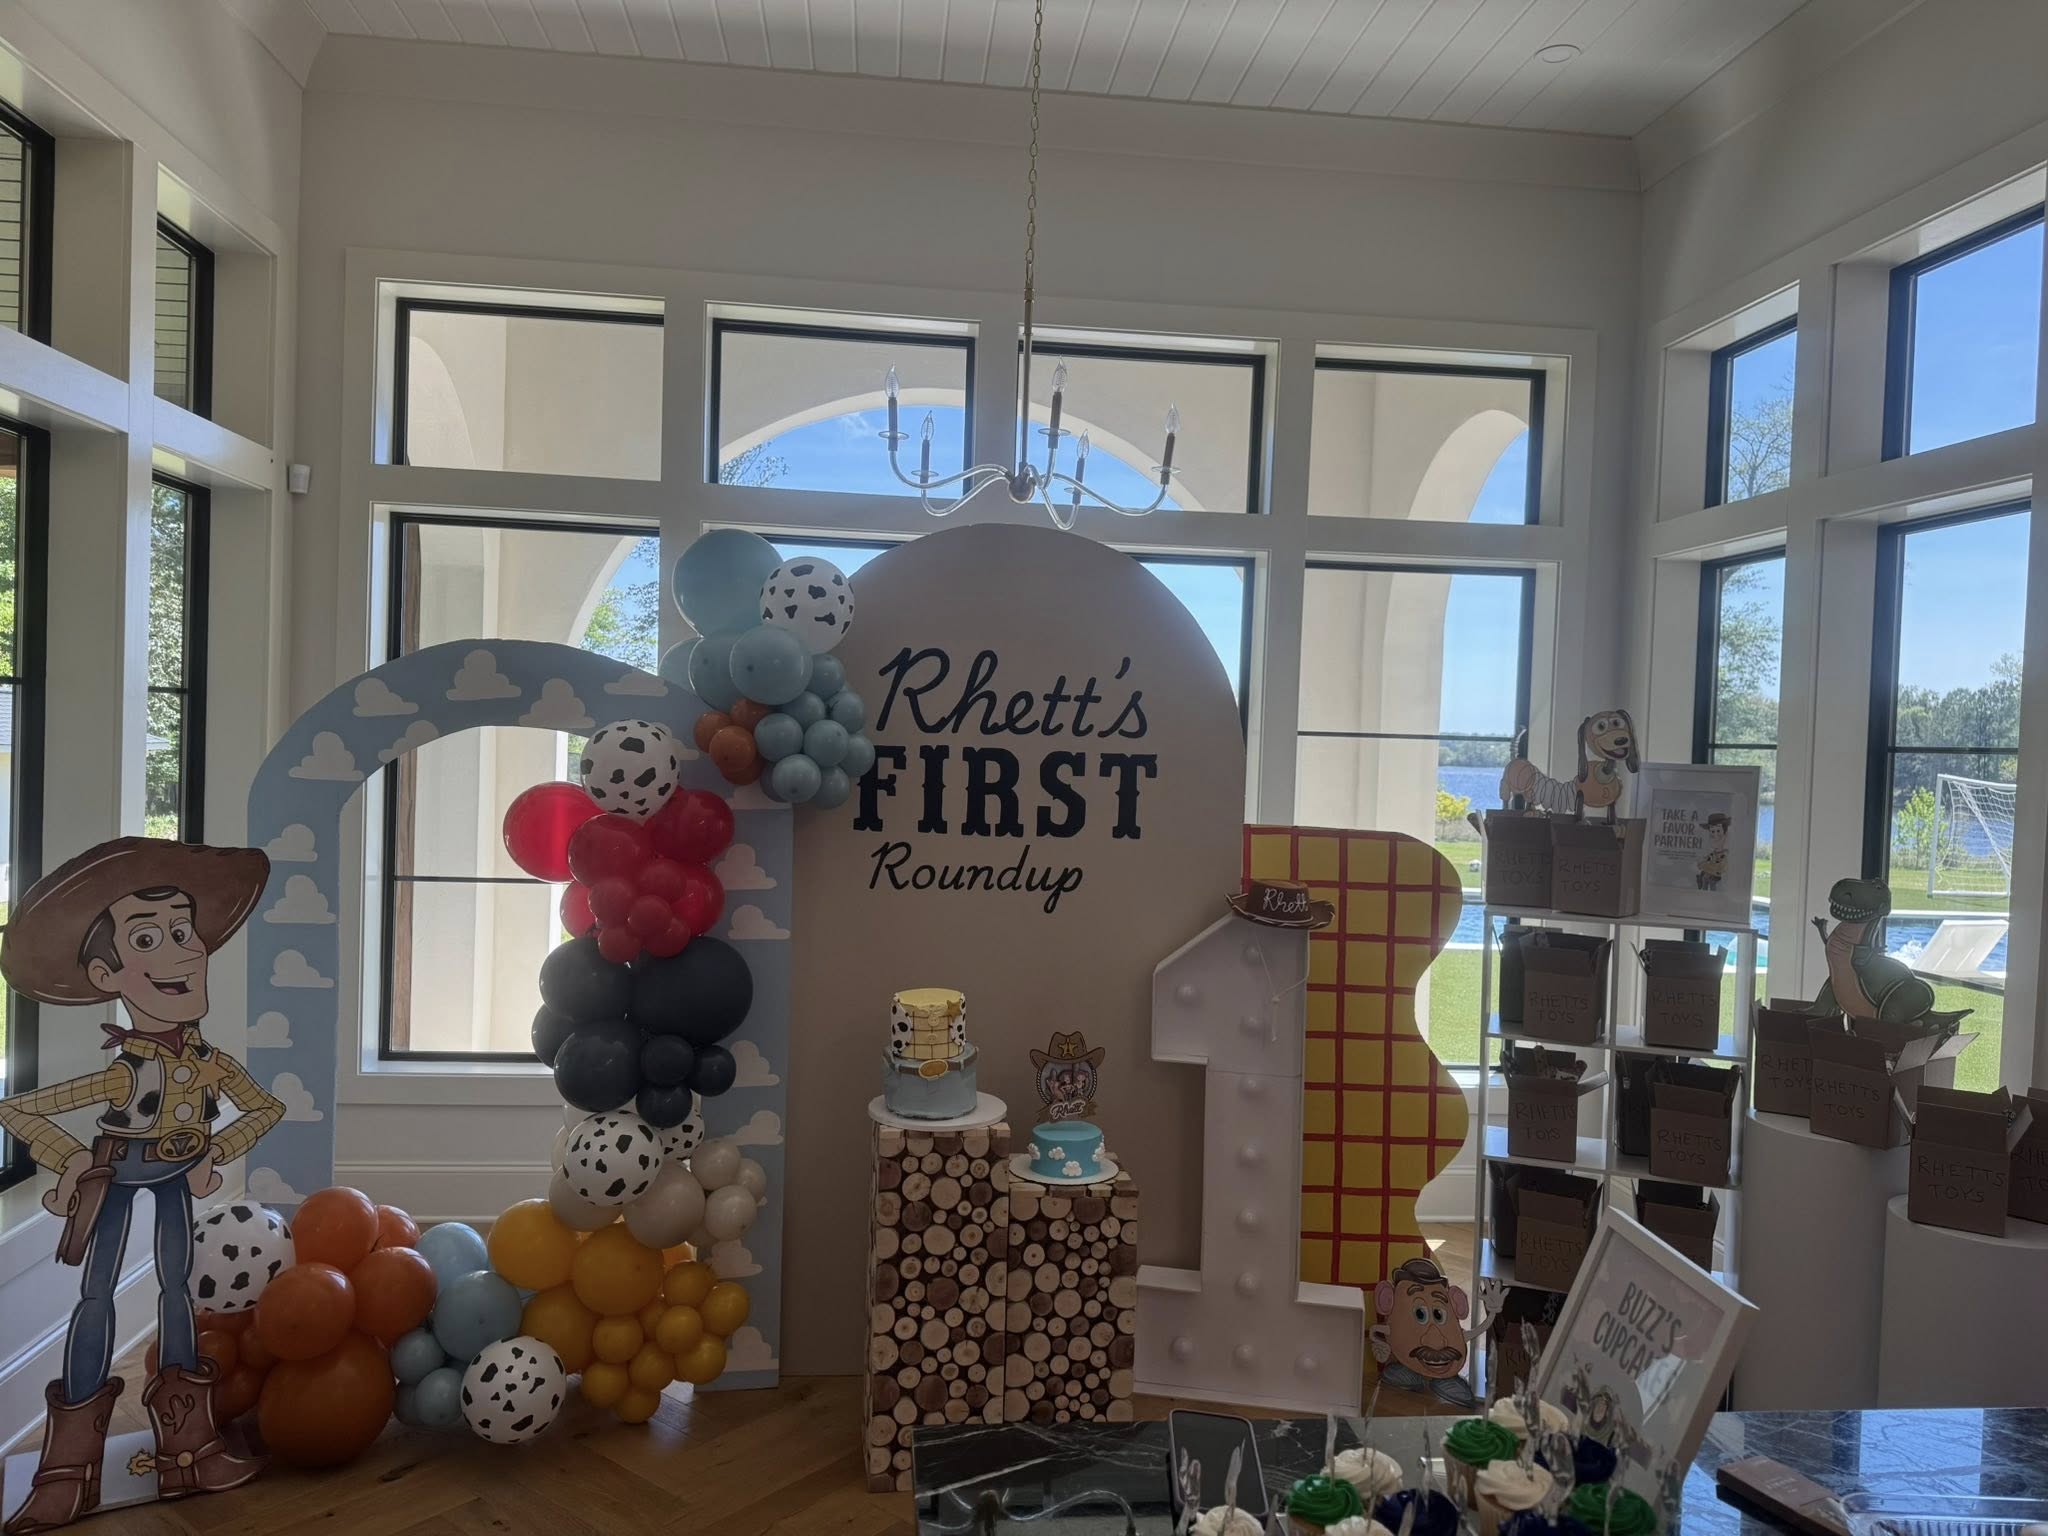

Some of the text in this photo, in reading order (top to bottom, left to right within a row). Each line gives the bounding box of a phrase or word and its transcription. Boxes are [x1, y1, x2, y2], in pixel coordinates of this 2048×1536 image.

[875, 646, 1148, 739] Rhett's
[852, 744, 1158, 840] FIRST
[1662, 808, 1698, 821] TAKE A
[1662, 821, 1696, 836] FAVOR
[869, 841, 1084, 914] Roundup
[1560, 878, 1601, 894] TOYS
[1536, 1008, 1576, 1024] TOYS
[1660, 1011, 1704, 1028] TOYS
[1824, 1103, 1865, 1119] TOYS
[1524, 1126, 1561, 1142] TOYS
[1663, 1150, 1706, 1165] TOYS
[1918, 1154, 2007, 1187] RHETTS
[1927, 1183, 1985, 1203] TOYS
[1526, 1252, 1570, 1272] TOYS
[1617, 1281, 1682, 1353] BUZZ'S
[1593, 1311, 1664, 1382] CUPCA
